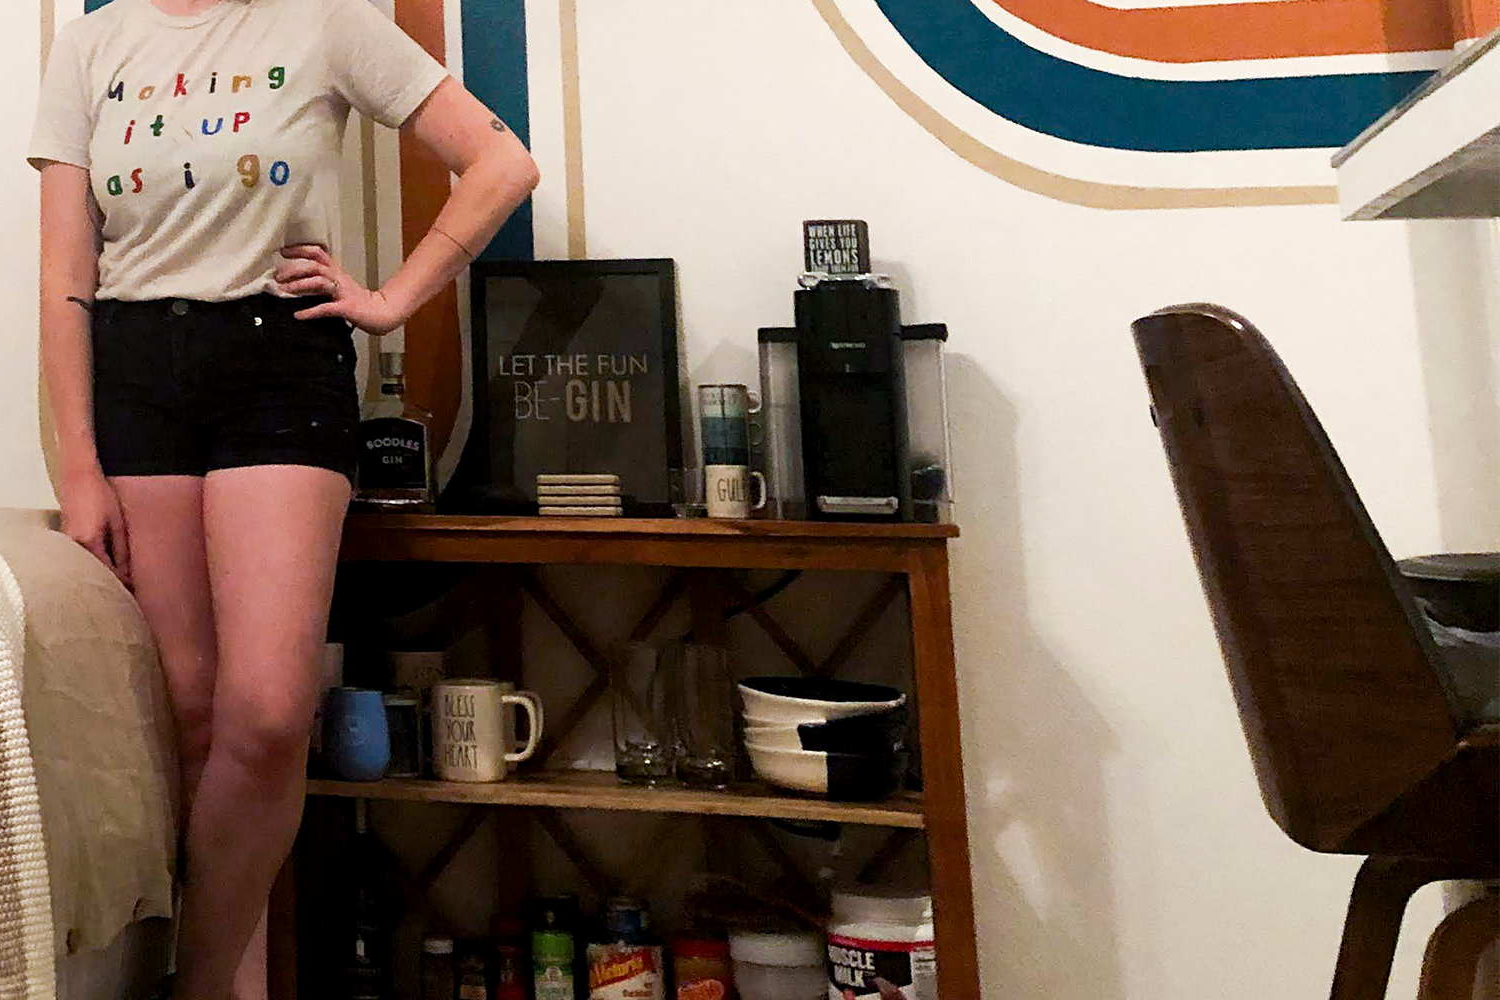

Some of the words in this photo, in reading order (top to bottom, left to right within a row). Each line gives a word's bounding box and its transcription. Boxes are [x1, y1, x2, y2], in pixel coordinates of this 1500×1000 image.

[123, 114, 165, 145] it
[106, 167, 143, 197] as
[183, 162, 195, 189] i
[236, 154, 290, 188] go
[808, 225, 835, 237] WHEN
[837, 224, 856, 237] LIFE
[809, 236, 836, 250] GIVES
[839, 237, 858, 249] YOU
[809, 249, 859, 265] LEMONS
[500, 354, 536, 376] LET
[544, 354, 588, 376] THE
[597, 353, 648, 376] FUN
[514, 379, 632, 424] BE-GIN
[381, 455, 403, 465] GIN
[444, 694, 475, 718] BLESS
[444, 720, 477, 742] YOUR
[444, 744, 478, 769] HEART
